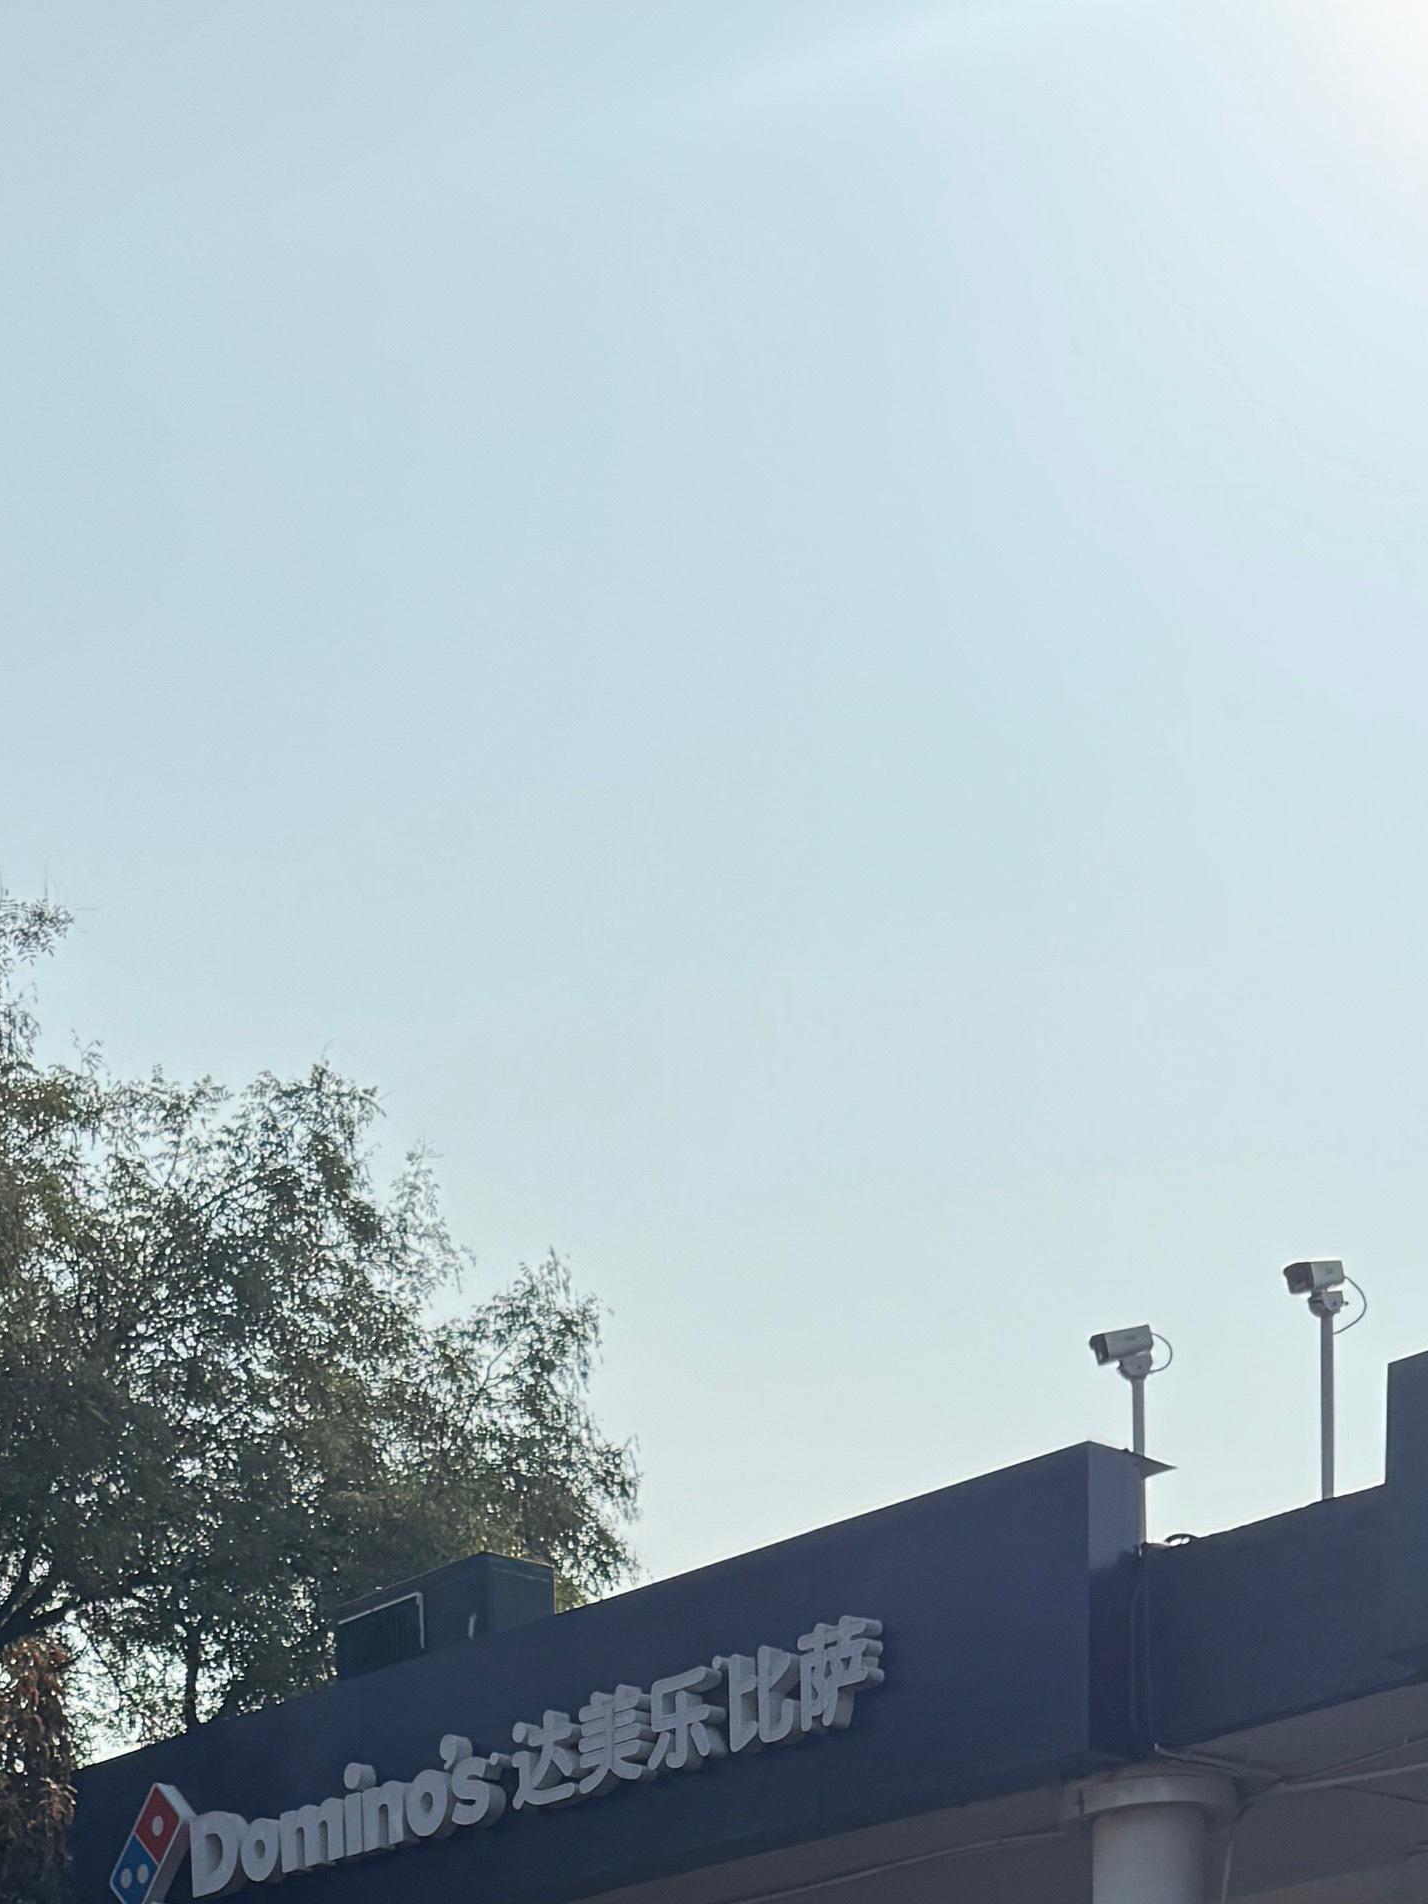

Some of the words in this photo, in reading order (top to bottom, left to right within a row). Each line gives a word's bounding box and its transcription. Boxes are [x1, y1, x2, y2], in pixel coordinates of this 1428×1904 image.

[191, 1734, 506, 1899] Domino's
[512, 1615, 884, 1811] 达美乐比萨
